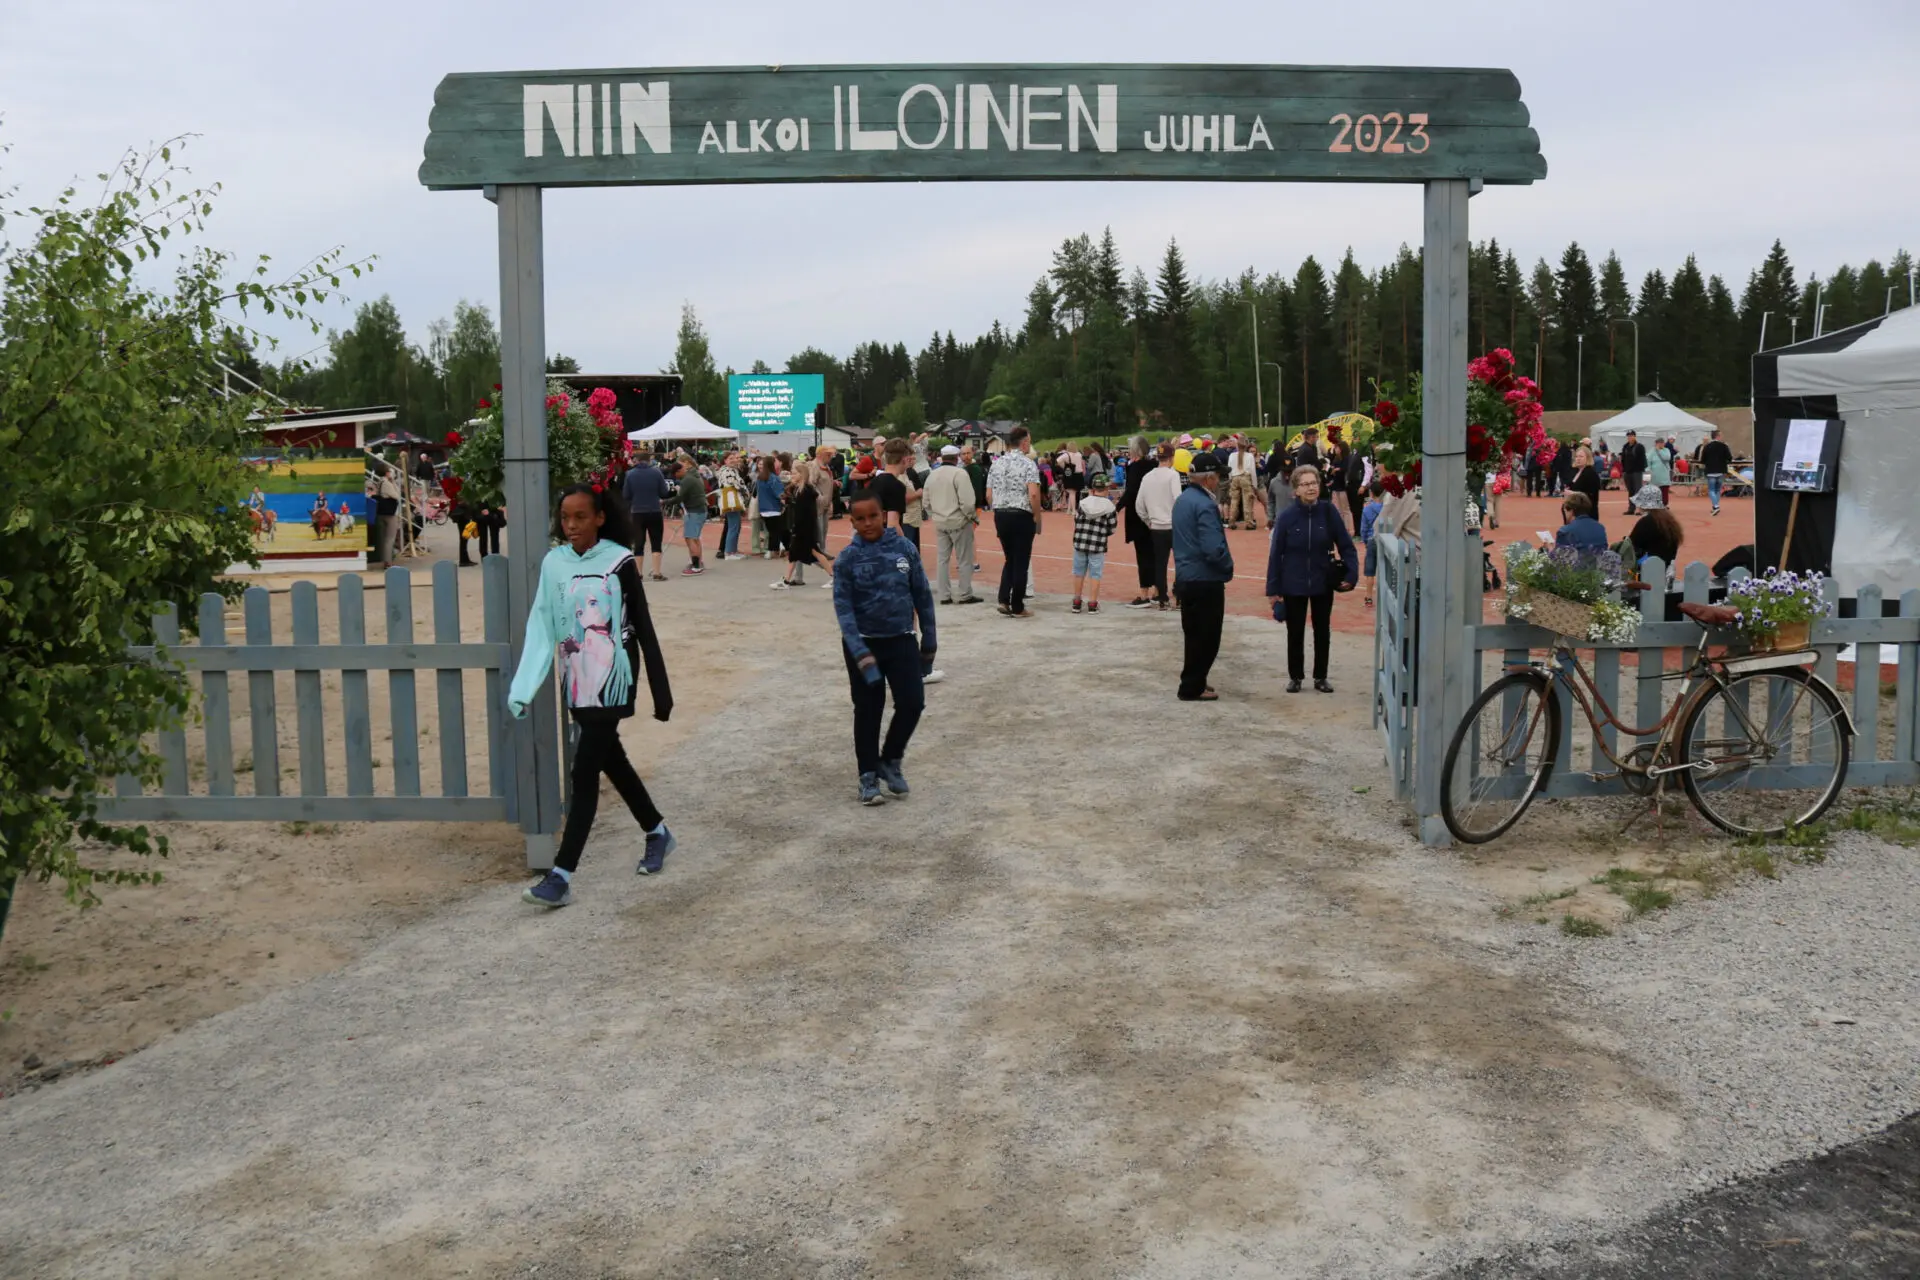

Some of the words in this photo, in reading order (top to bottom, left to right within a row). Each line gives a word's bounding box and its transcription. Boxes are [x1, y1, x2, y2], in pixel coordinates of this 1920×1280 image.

[523, 81, 672, 158] NIIN
[698, 117, 810, 154] ALKOI
[833, 83, 1118, 153] ILOINEN
[1144, 114, 1274, 152] JUHLA
[1328, 112, 1430, 154] 2023
